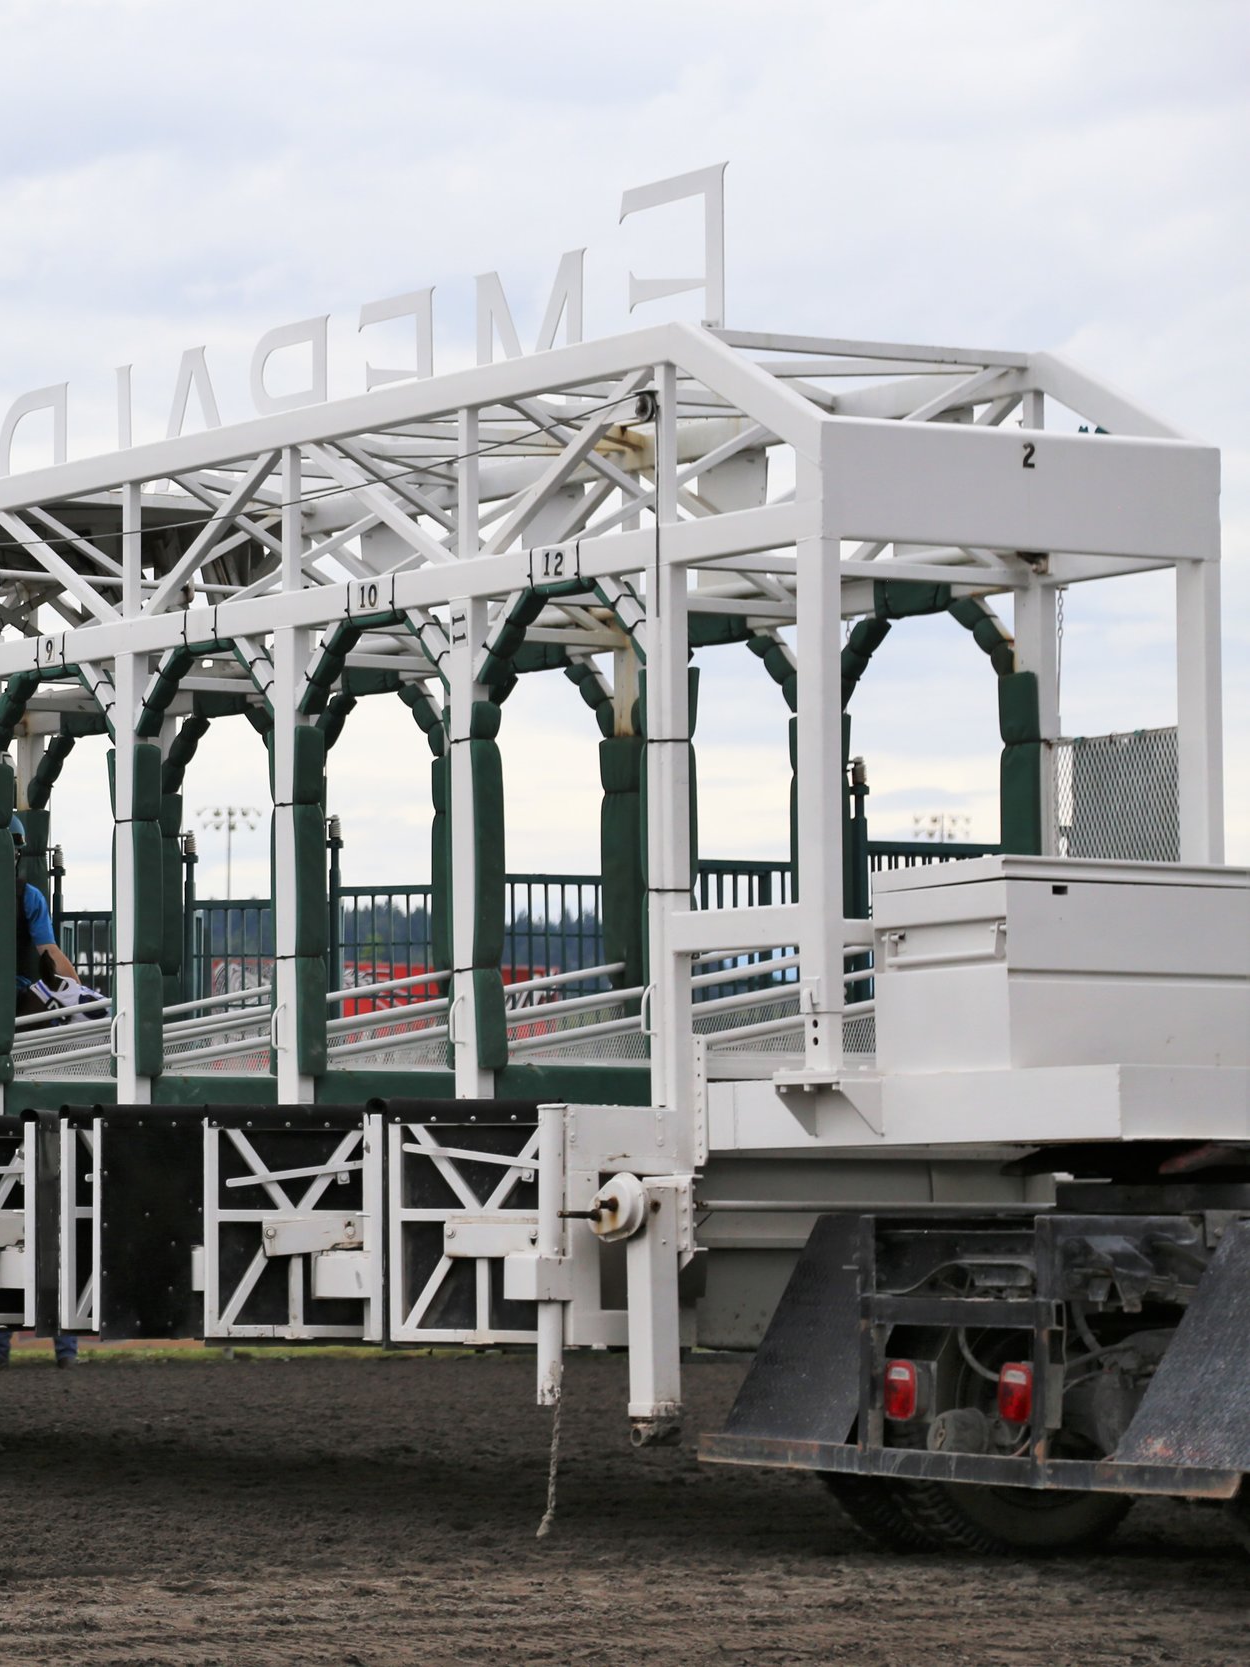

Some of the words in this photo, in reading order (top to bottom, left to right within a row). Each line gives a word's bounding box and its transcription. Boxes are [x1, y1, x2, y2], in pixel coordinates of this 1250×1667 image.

[1022, 442, 1036, 468] 2
[543, 551, 565, 576] 12
[359, 583, 378, 608] 10
[45, 639, 54, 661] 9
